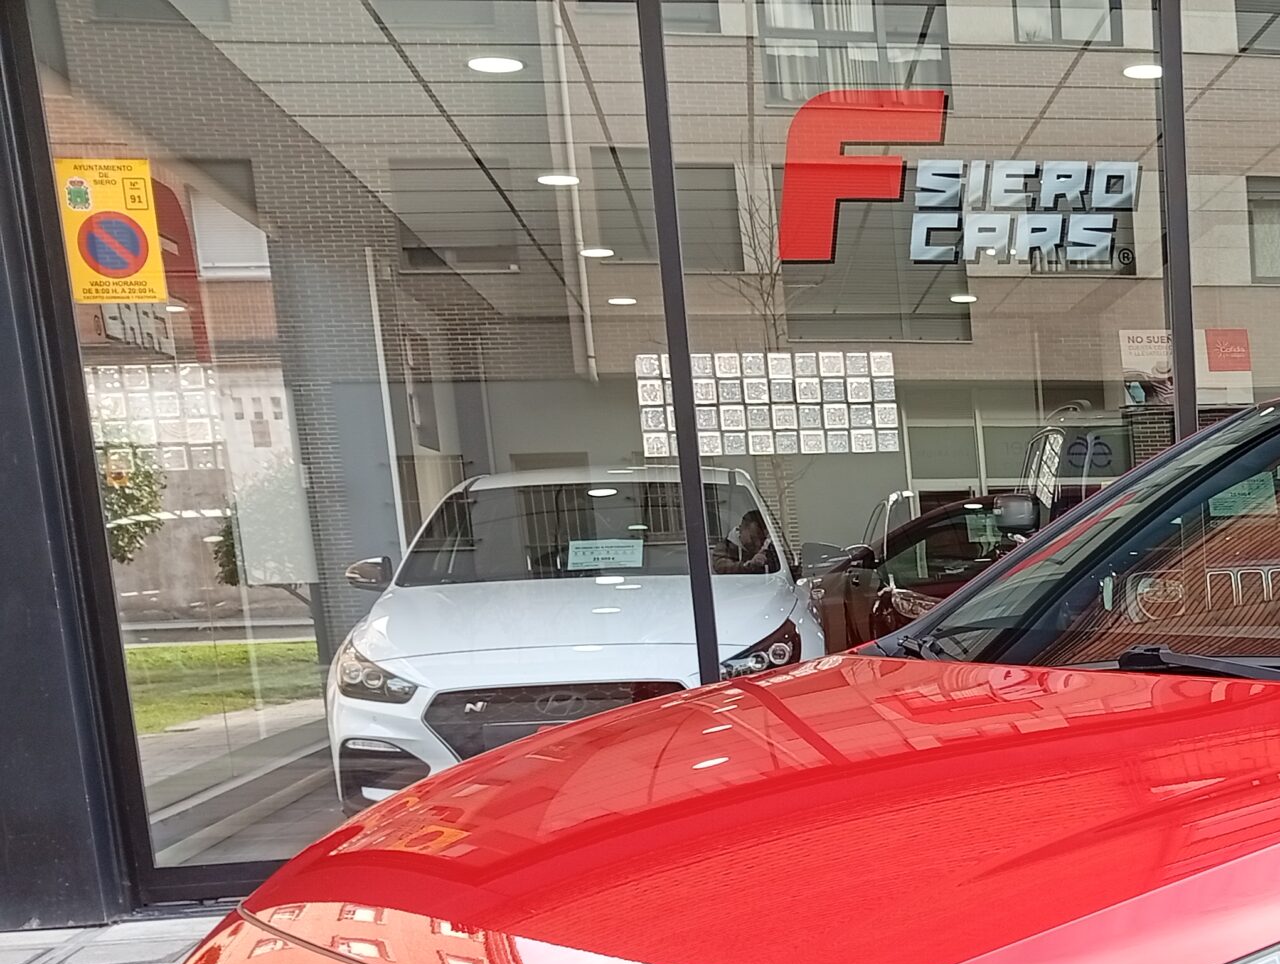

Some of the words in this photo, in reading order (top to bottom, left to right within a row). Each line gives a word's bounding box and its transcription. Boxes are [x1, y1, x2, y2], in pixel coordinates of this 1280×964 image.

[72, 164, 133, 172] AYUNTAMIENTO
[914, 159, 1142, 211] SIERO
[130, 194, 143, 204] 91
[910, 212, 1117, 264] CARS
[1127, 335, 1144, 344] NO
